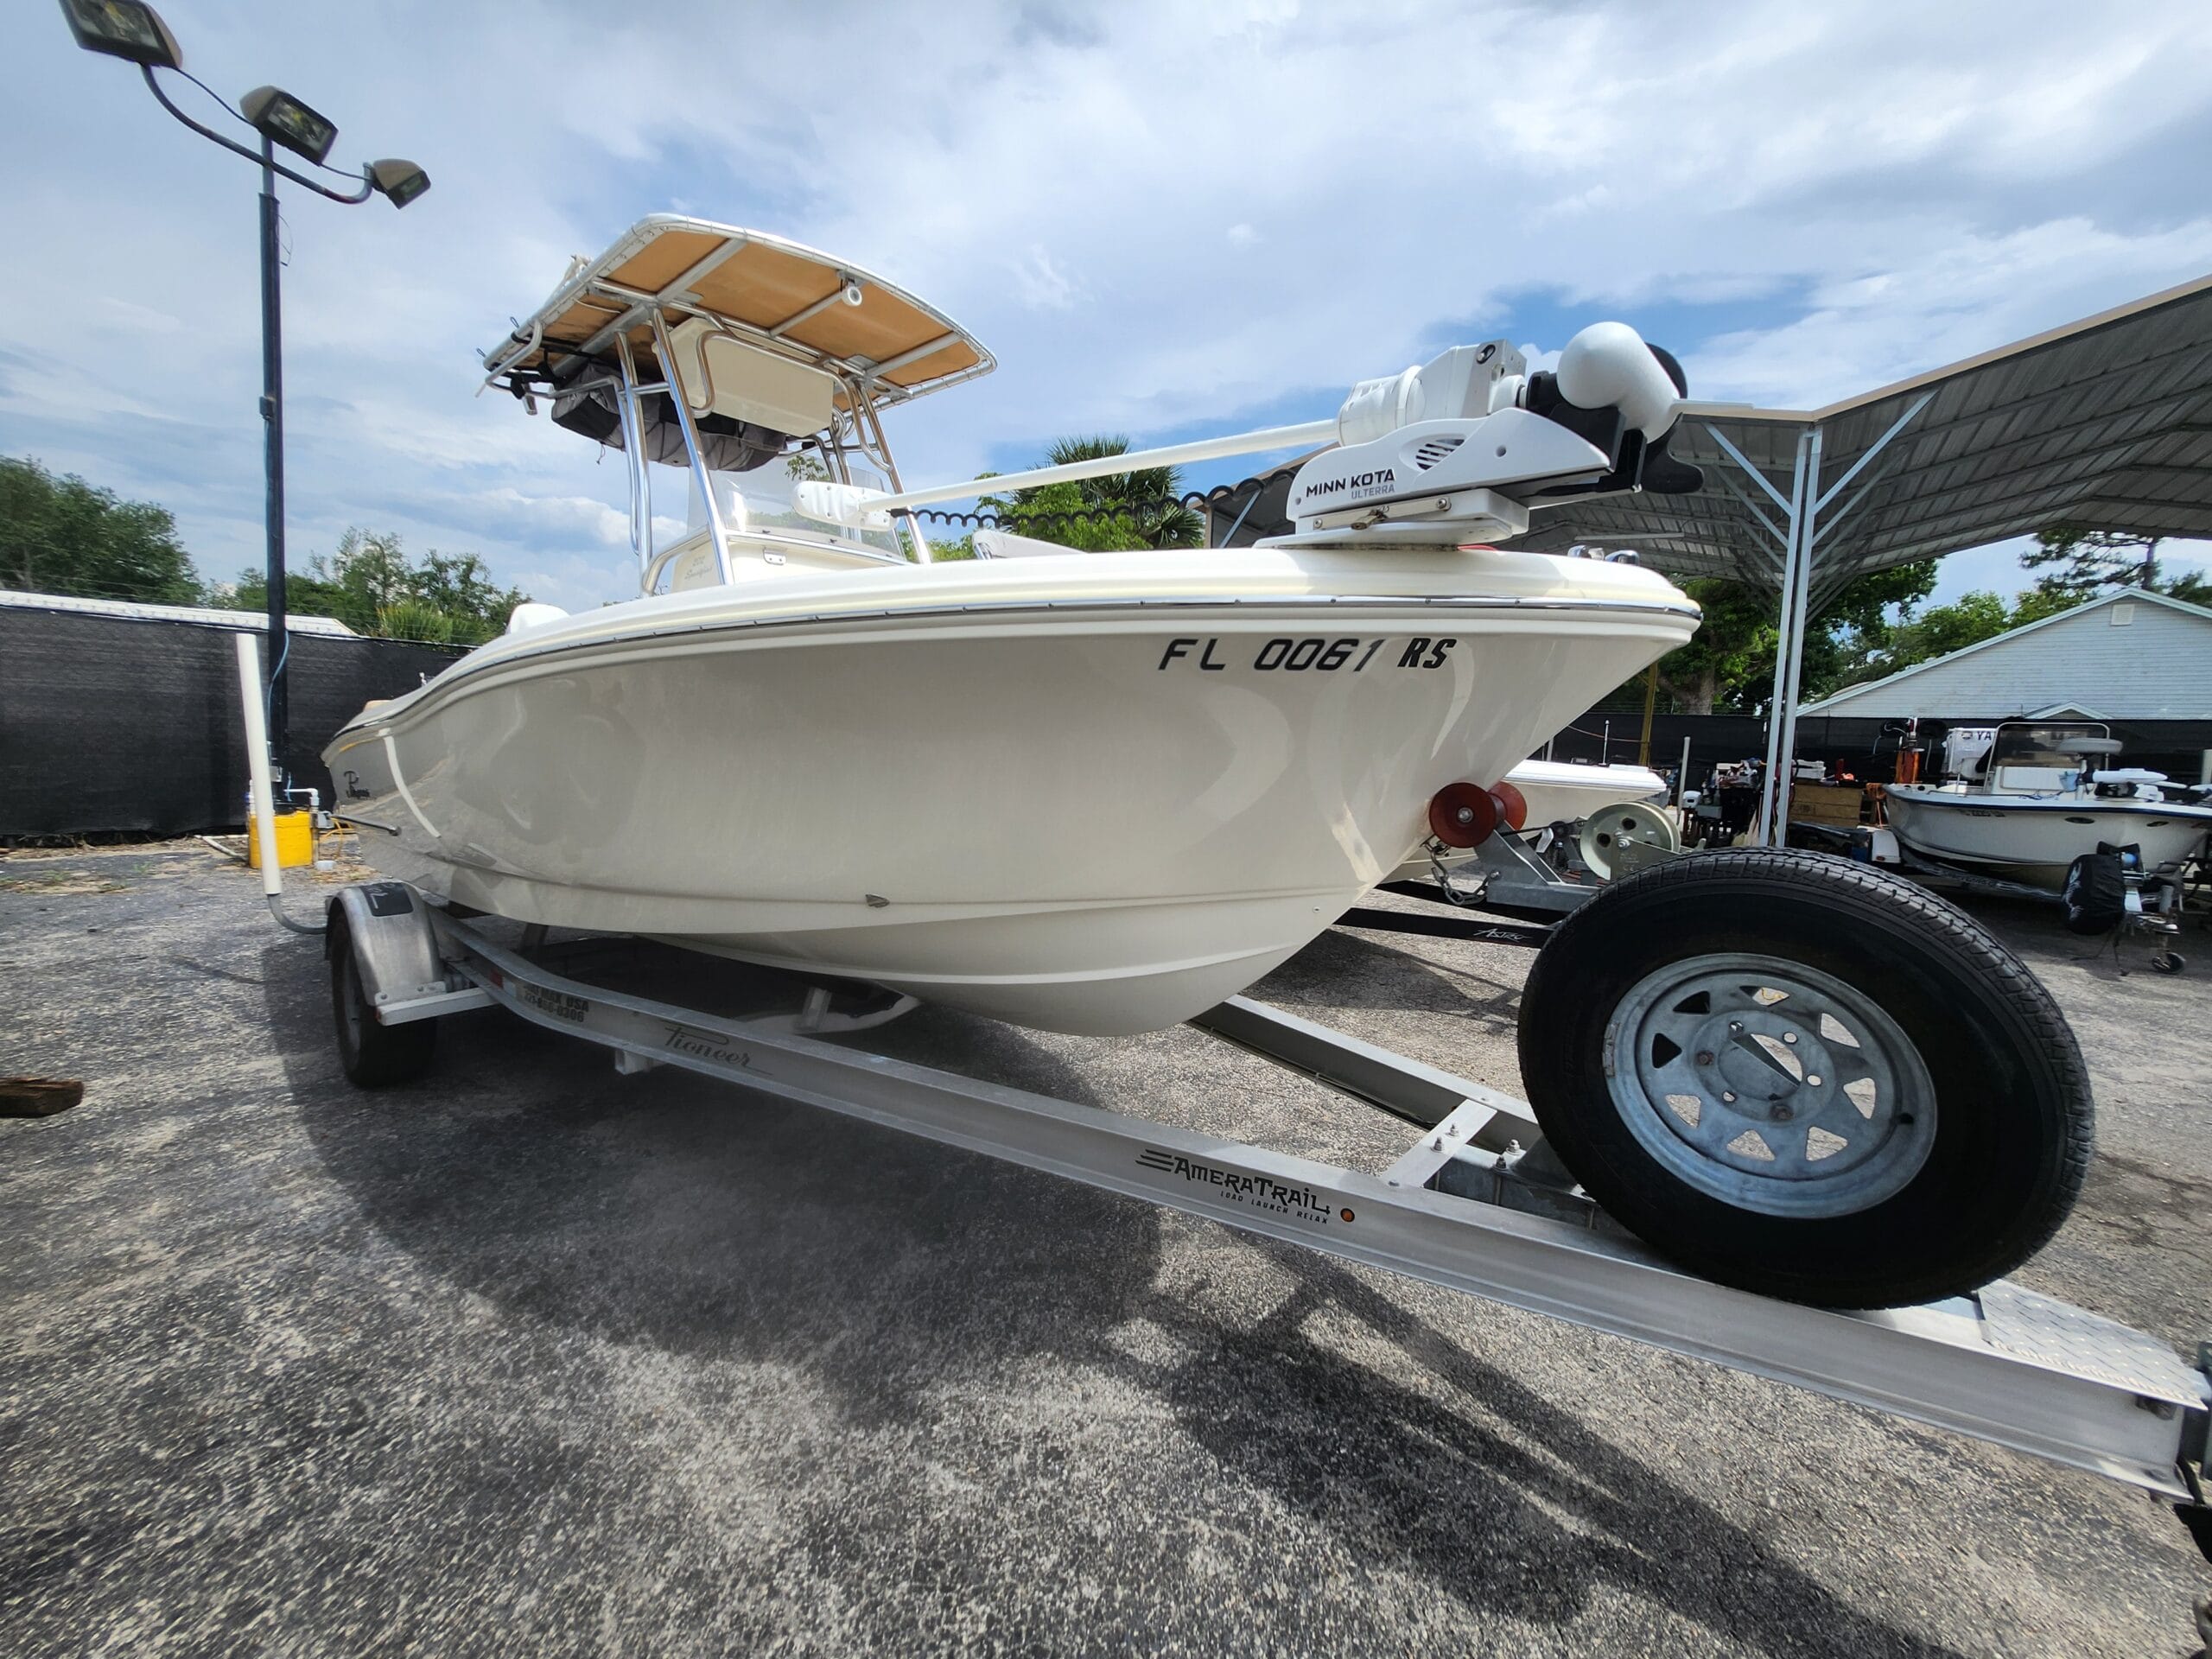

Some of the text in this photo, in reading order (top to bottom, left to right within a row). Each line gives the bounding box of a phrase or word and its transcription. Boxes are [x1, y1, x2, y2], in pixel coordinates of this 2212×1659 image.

[1306, 468, 1395, 498] MINN KOTA
[1351, 484, 1395, 499] ULTERRA
[1158, 637, 1458, 671] FL 0061 RS
[566, 994, 589, 1012] USA
[662, 1020, 773, 1076] Pioneer
[1220, 1190, 1328, 1224] LOAD LAUNCH RELAX
